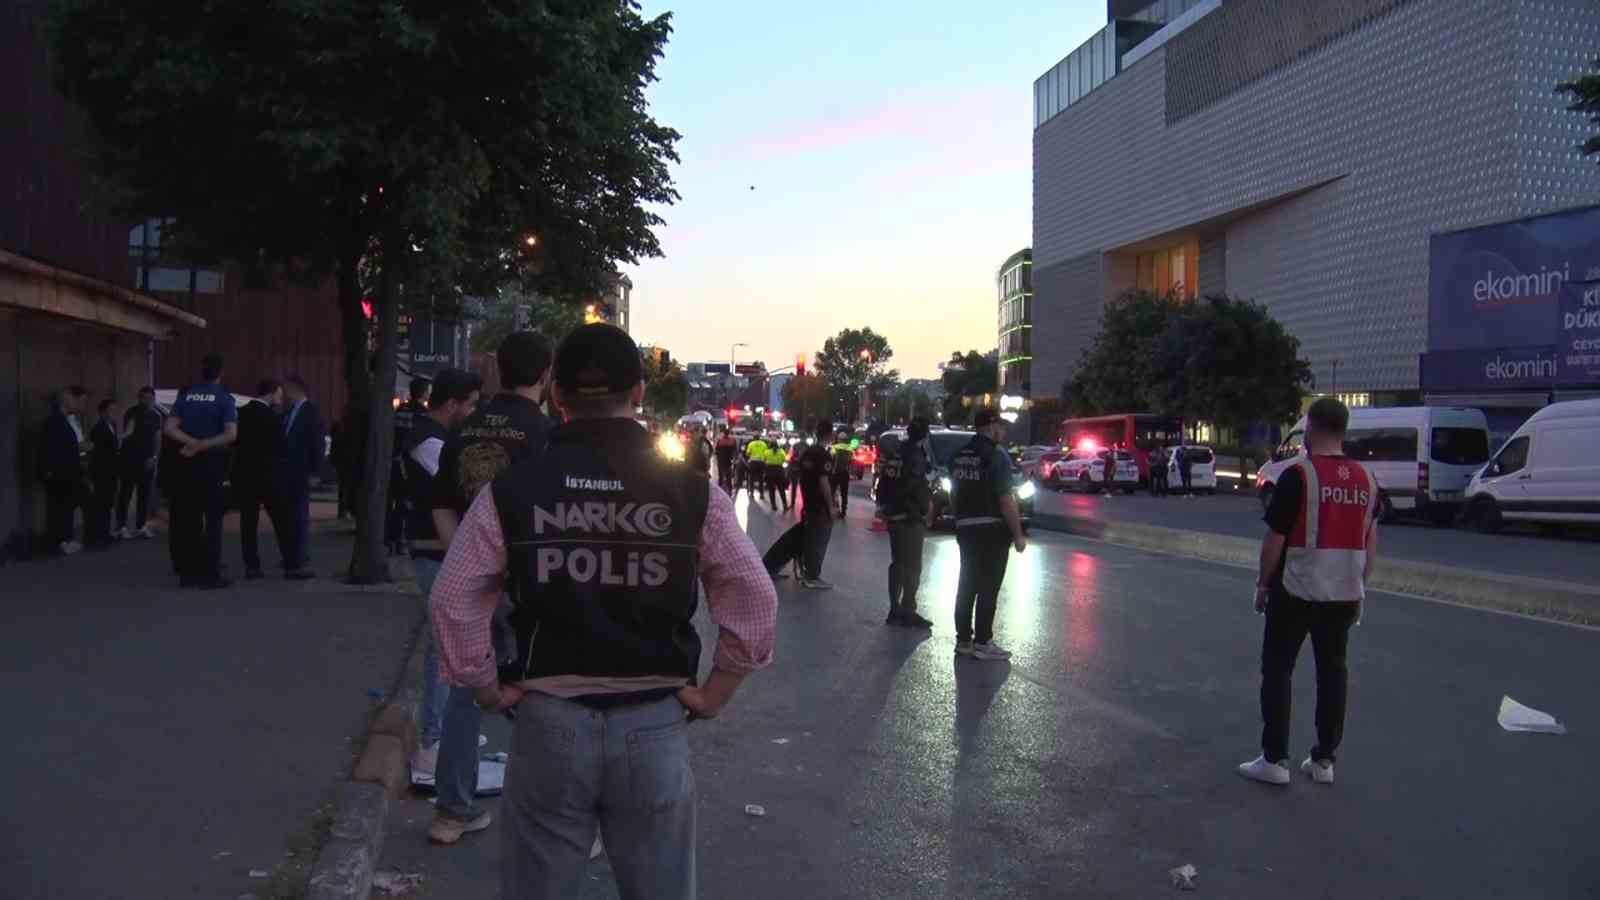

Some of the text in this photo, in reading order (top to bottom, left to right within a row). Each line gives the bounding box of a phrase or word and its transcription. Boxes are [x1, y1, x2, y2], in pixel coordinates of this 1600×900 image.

[1473, 261, 1569, 301] ekomini
[1564, 307, 1600, 329] DÜK
[1486, 353, 1557, 378] ekomini
[533, 501, 673, 537] NARKO
